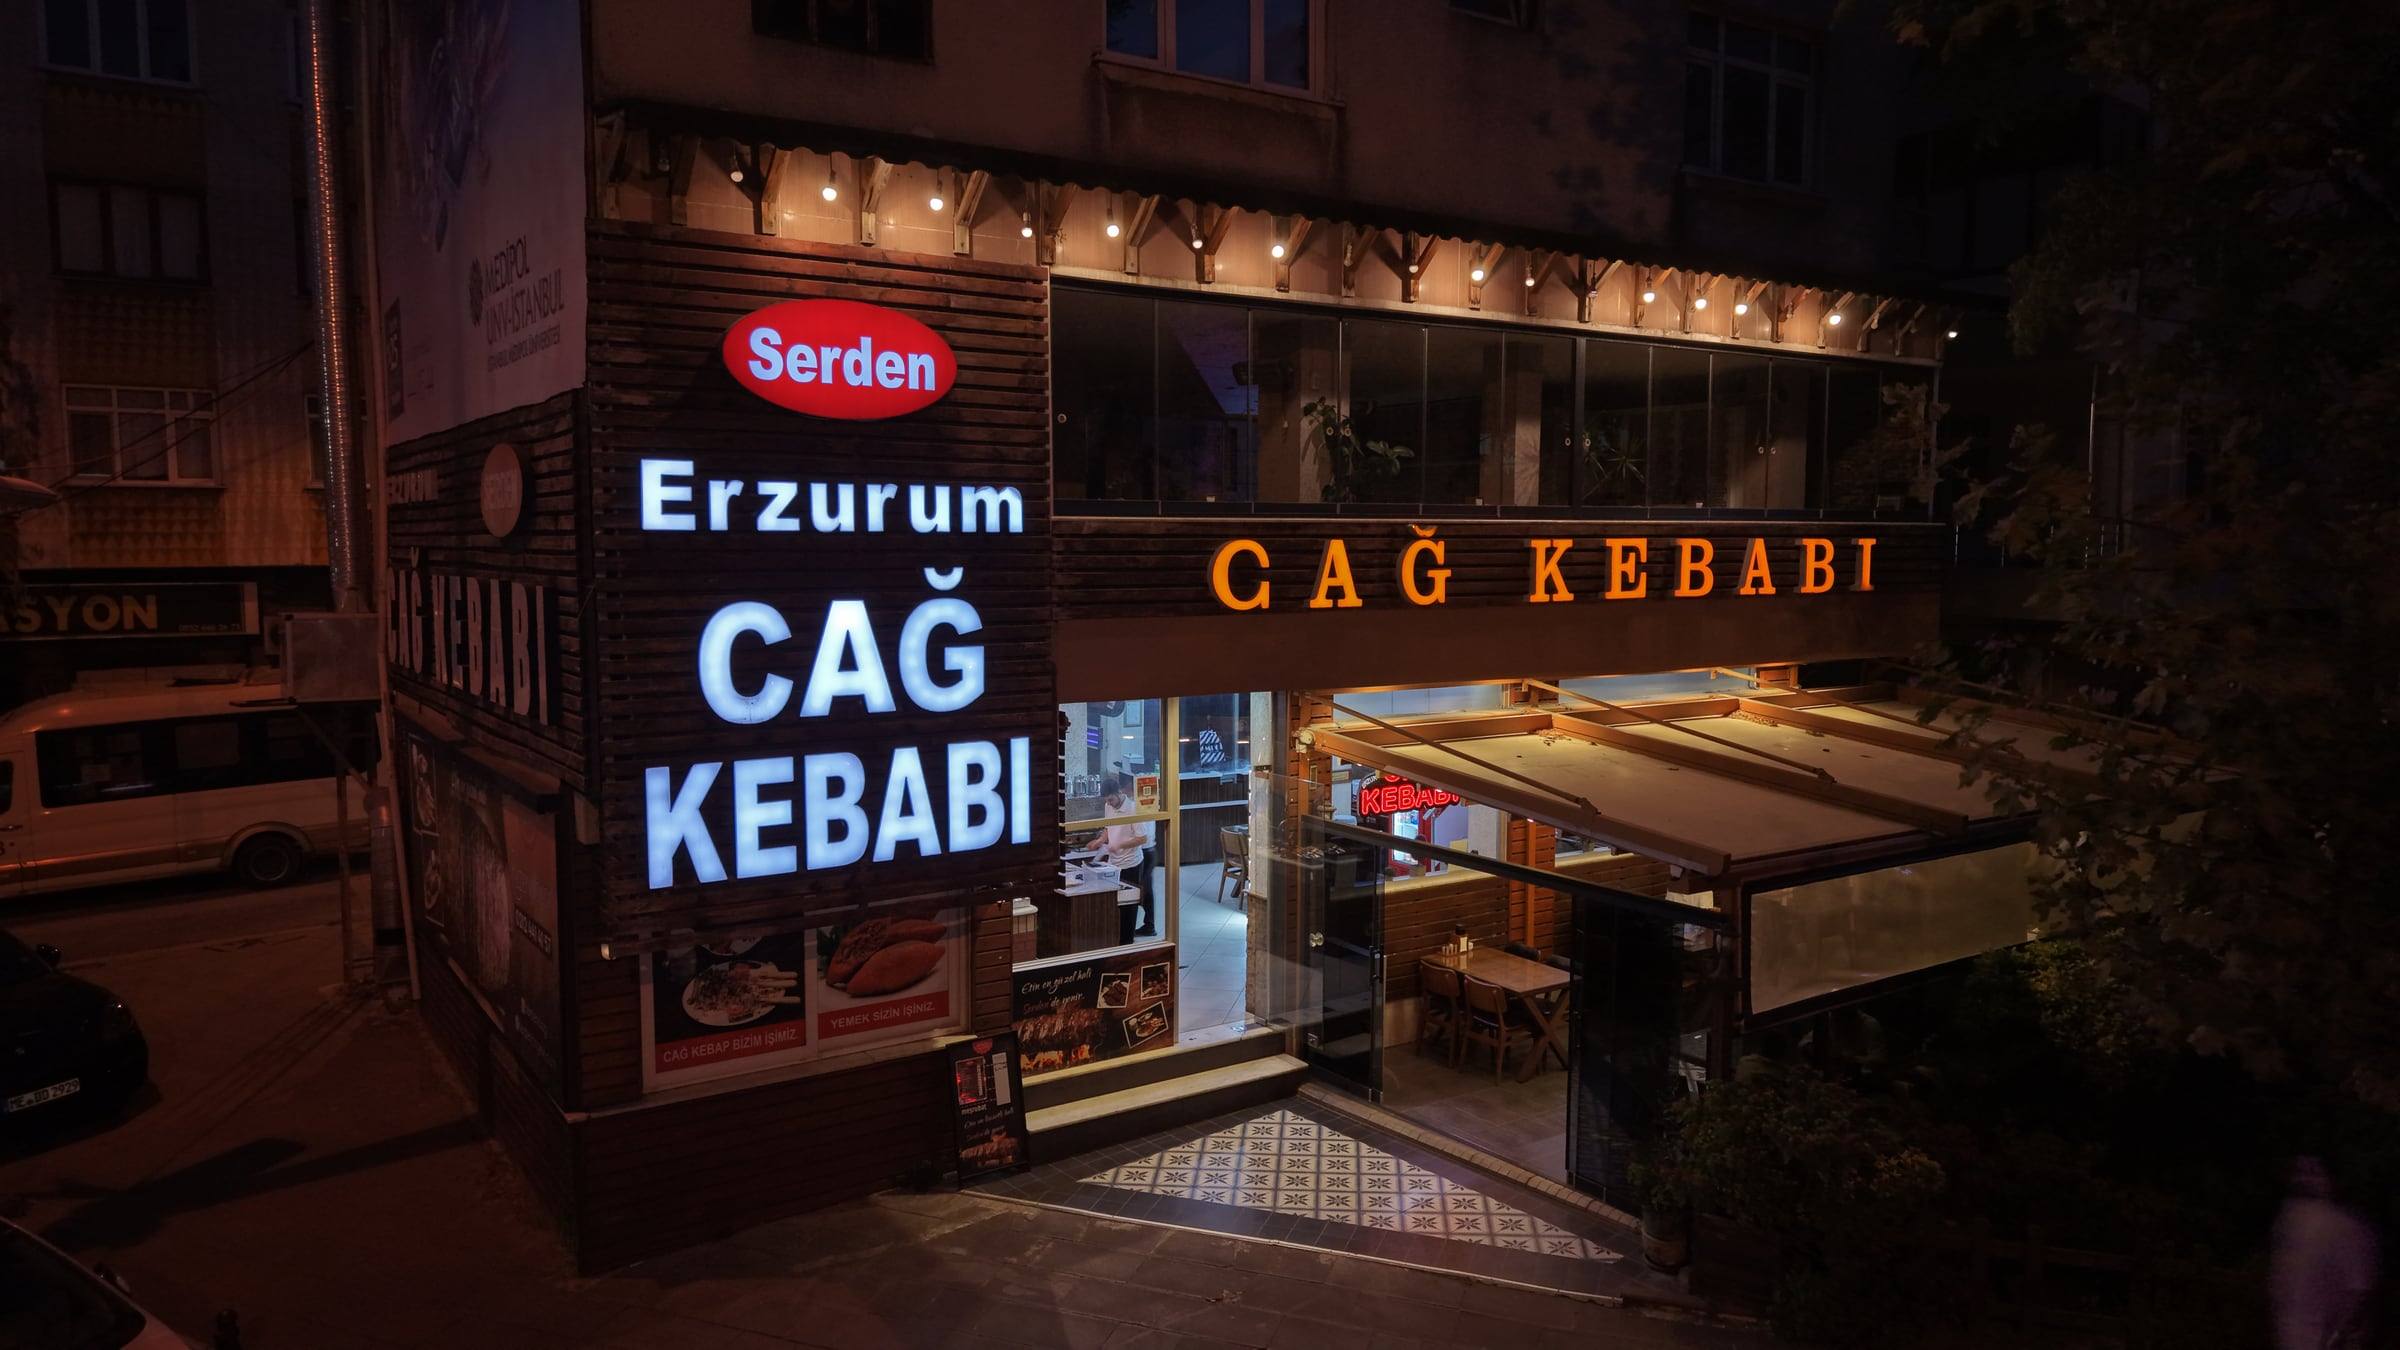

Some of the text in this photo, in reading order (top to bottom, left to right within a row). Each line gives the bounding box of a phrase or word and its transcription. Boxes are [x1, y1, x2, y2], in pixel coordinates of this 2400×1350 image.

[484, 234, 529, 293] MEDİPOL
[748, 327, 936, 391] Serden
[640, 458, 1024, 533] Erzurum
[1209, 524, 1877, 611] CAĞ KEBABI
[431, 574, 549, 726] KEBABI
[698, 566, 985, 724] CAĞ
[645, 736, 1031, 890] KEBABI
[663, 1046, 689, 1063] CAĞ
[691, 1040, 730, 1057] KEBAP
[732, 1033, 762, 1050] BİZİM
[831, 1013, 869, 1029] YEMEK
[872, 1007, 900, 1021] SİZİN
